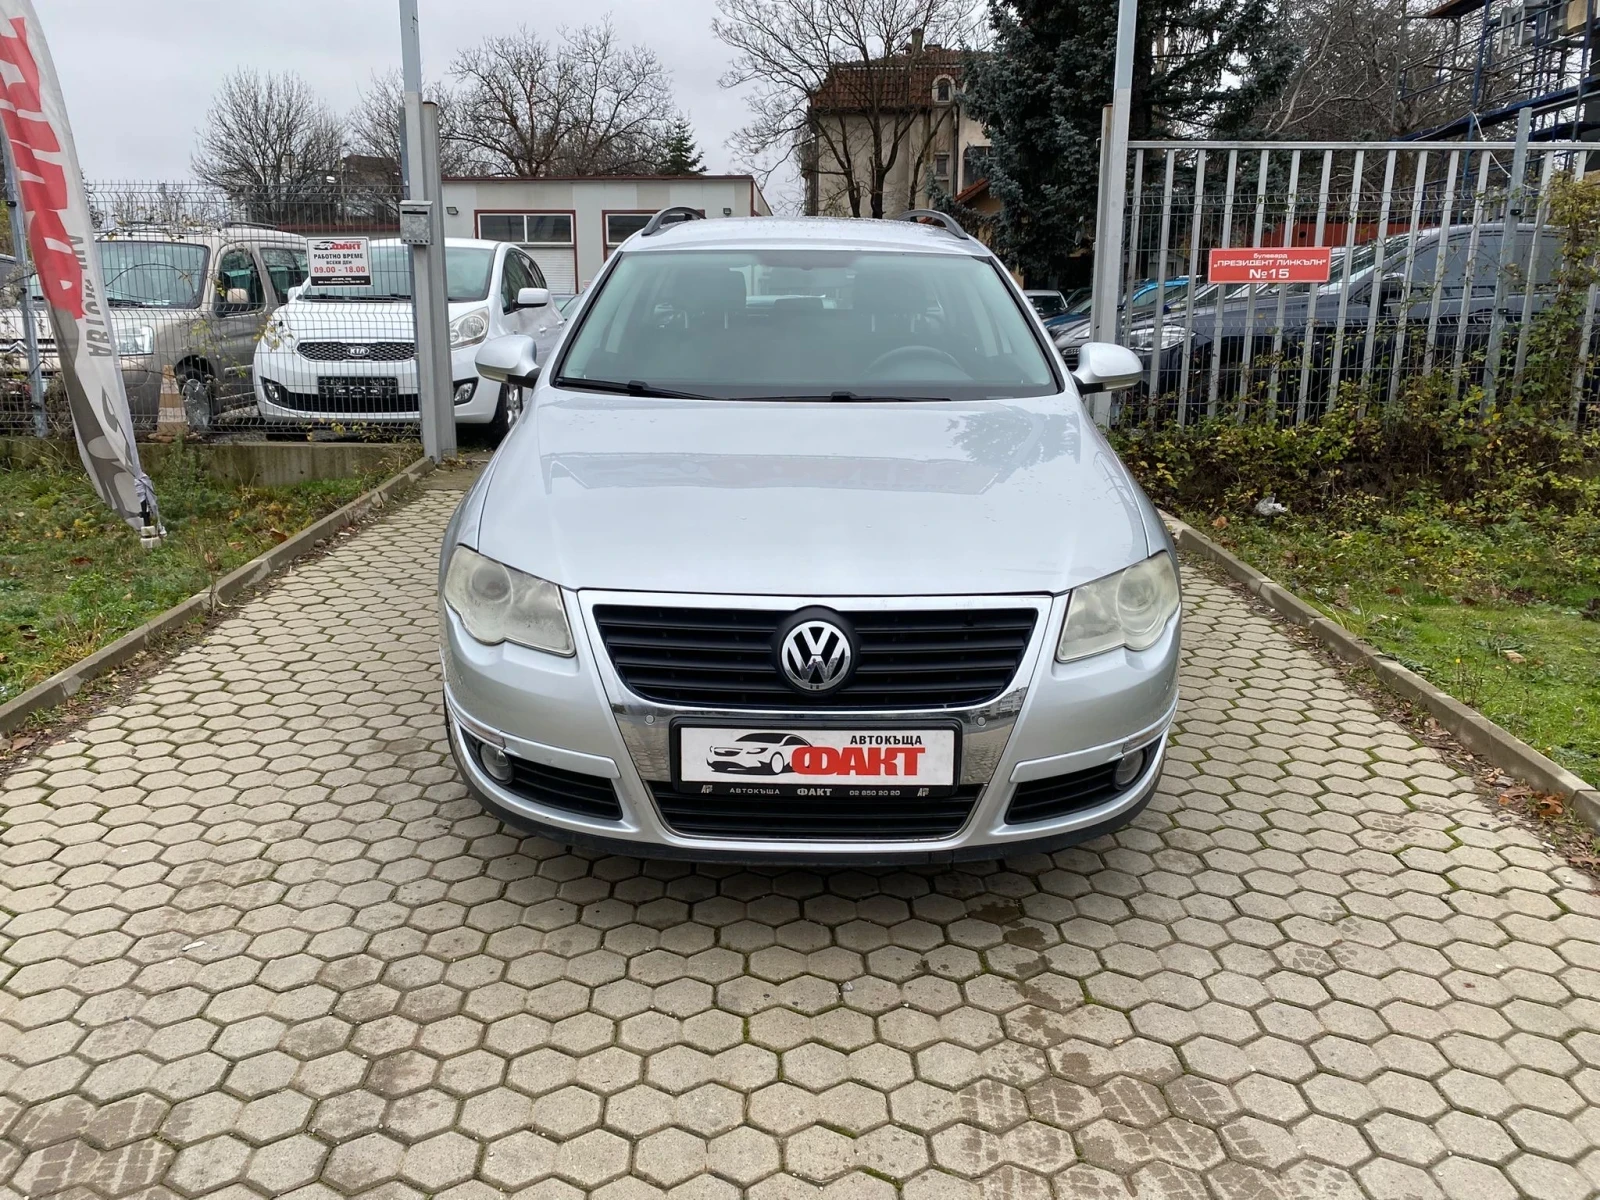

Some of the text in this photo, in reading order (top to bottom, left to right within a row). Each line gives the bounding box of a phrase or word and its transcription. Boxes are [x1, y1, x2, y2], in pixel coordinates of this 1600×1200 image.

[850, 735, 922, 746] АВТОКЪЩА
[790, 746, 926, 776] ФАКТ
[797, 788, 832, 796] ФАКТ
